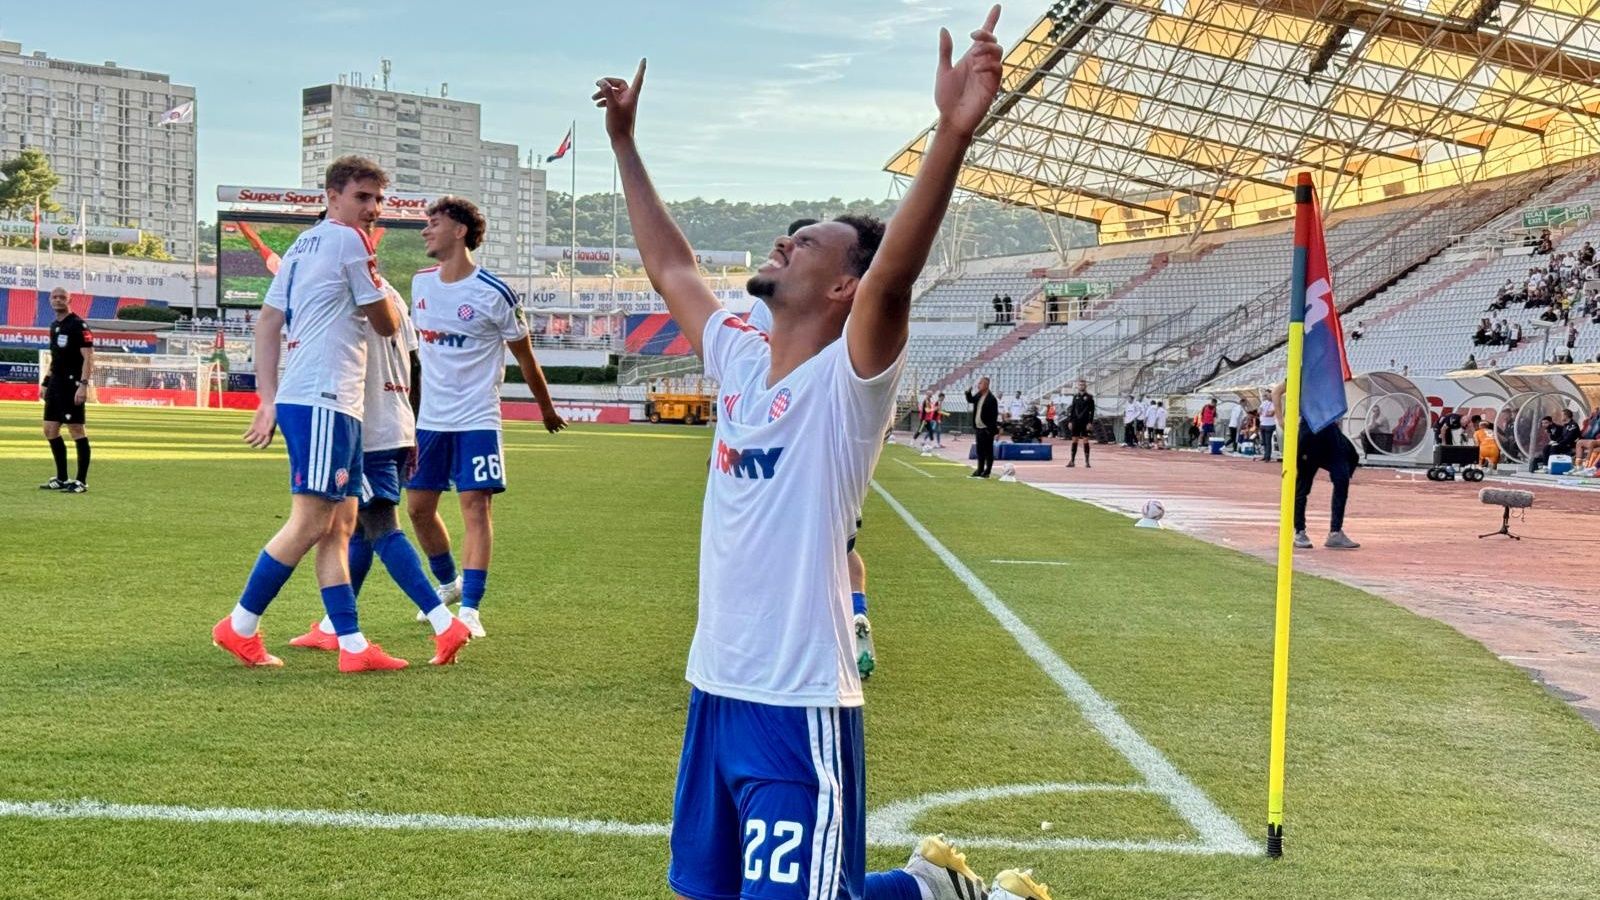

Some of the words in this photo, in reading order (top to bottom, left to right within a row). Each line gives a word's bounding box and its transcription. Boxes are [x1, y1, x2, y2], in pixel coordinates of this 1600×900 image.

[238, 189, 282, 202] Super
[284, 191, 325, 204] Sport
[387, 196, 427, 208] Sport
[43, 269, 59, 278] 1952
[64, 271, 80, 280] 1955
[105, 274, 122, 283] 1974
[126, 276, 143, 285] 1975
[147, 278, 164, 286] 1979
[533, 293, 556, 302] KUP
[24, 335, 50, 345] HAJD
[102, 338, 148, 348] HAJDUKA
[716, 438, 784, 479] TOMMY
[472, 454, 501, 482] 26
[744, 819, 803, 884] 22
